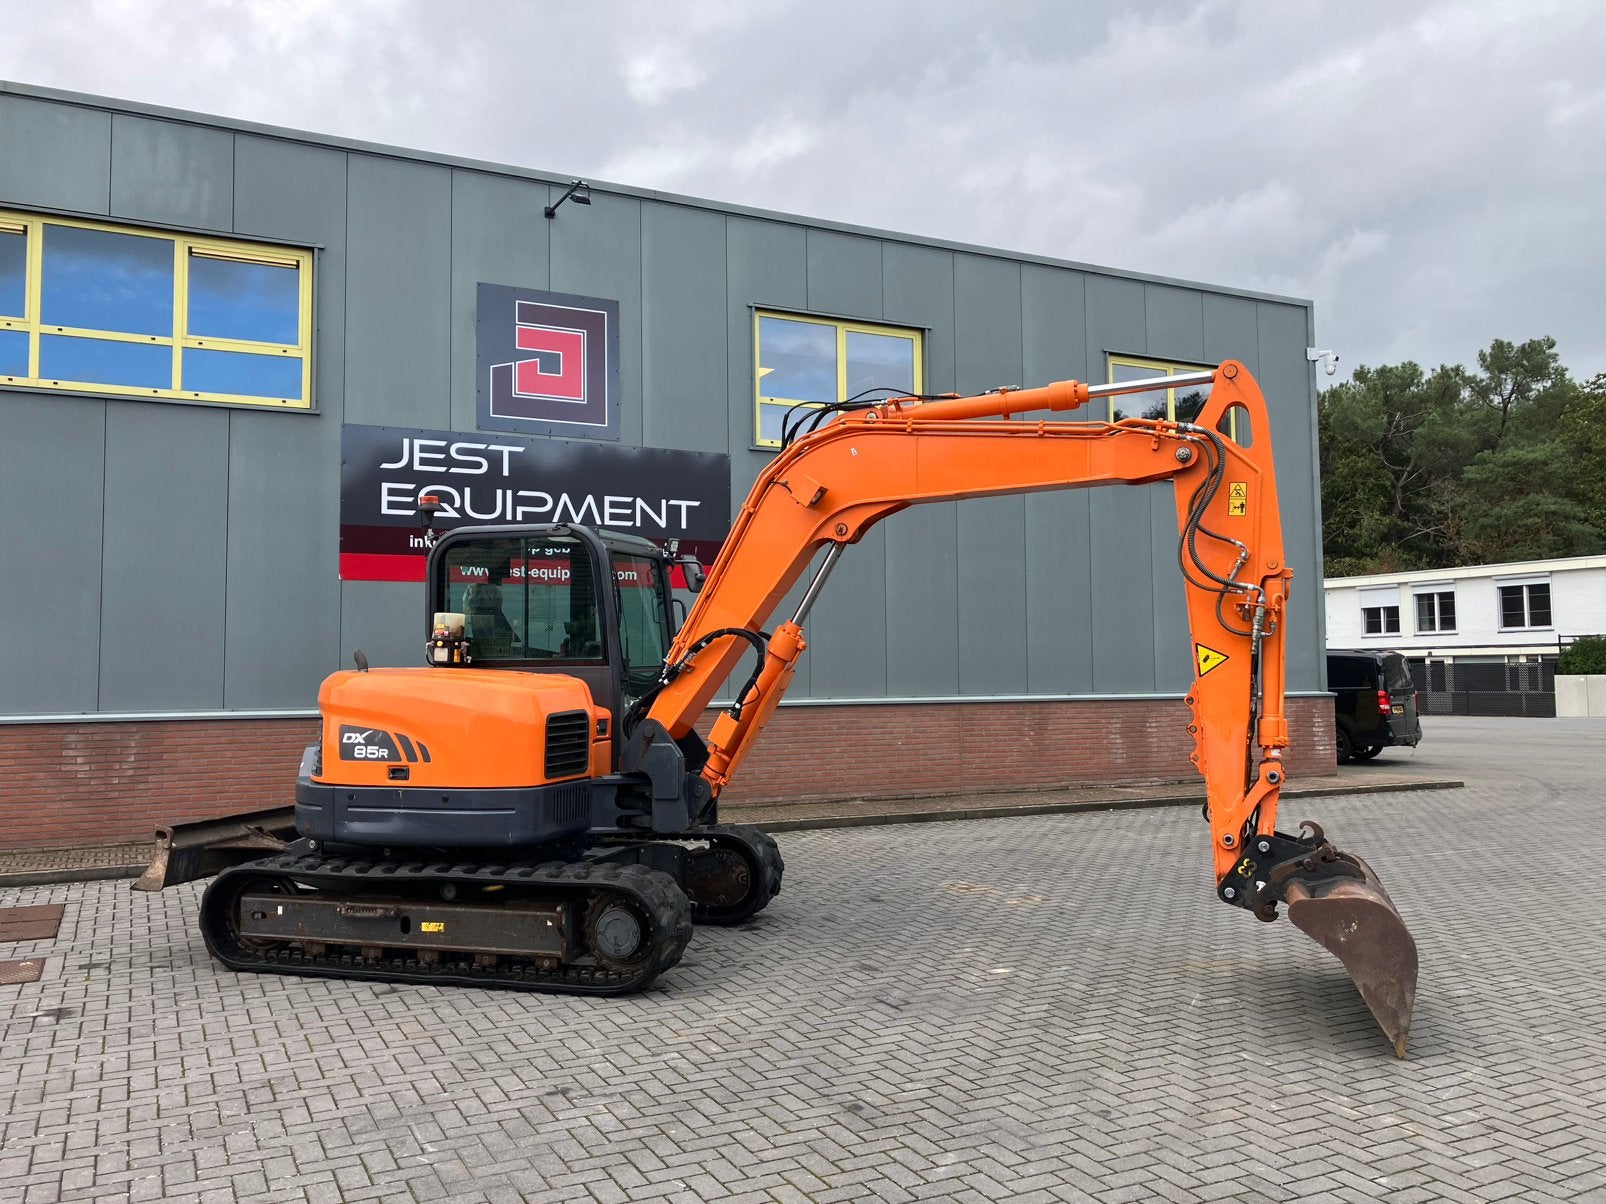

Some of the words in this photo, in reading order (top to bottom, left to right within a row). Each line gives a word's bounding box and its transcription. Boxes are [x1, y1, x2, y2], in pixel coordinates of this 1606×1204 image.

[379, 438, 526, 477] JEST
[380, 482, 701, 530] EQUIPMENT
[409, 535, 438, 548] ink
[342, 730, 374, 744] DX
[354, 745, 389, 759] 85R
